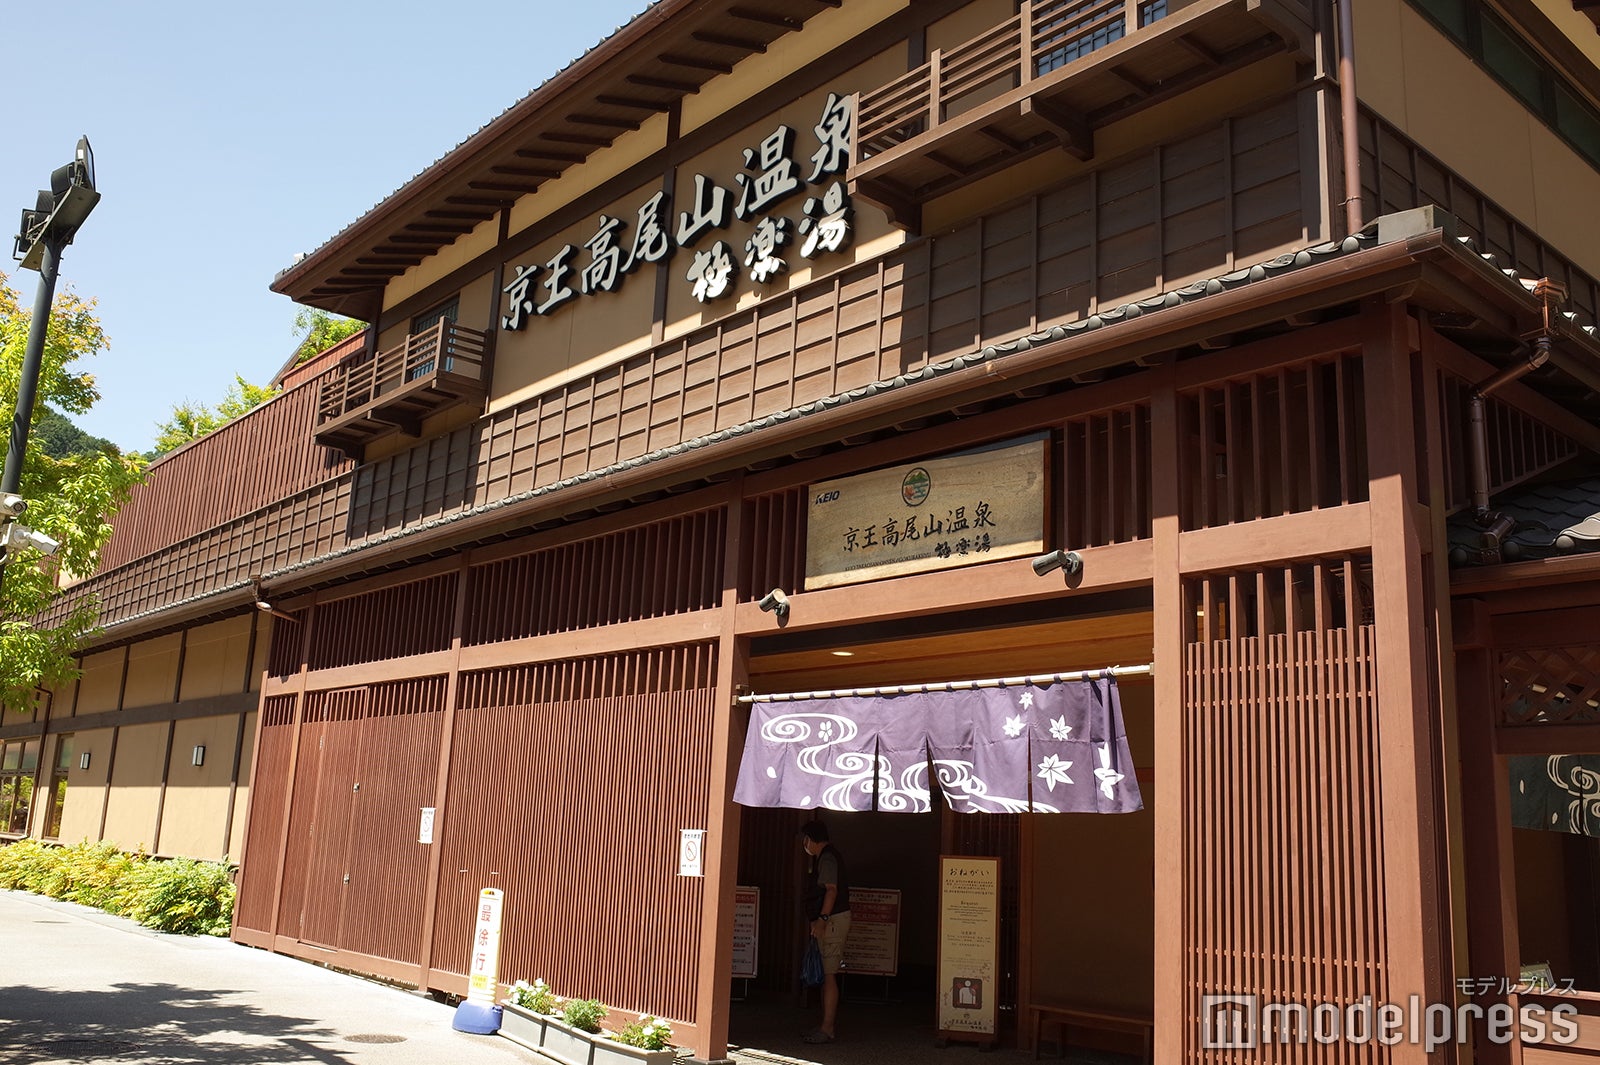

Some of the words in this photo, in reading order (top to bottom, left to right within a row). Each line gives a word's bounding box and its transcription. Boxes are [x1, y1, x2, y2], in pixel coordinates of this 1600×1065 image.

[500, 92, 853, 331] 京王高尾山温泉
[686, 182, 852, 303] 極楽湯
[815, 490, 840, 505] KEIO
[842, 500, 996, 552] 京王高尾山温泉
[934, 532, 991, 559] 極楽湯
[475, 904, 492, 971] 最徐行
